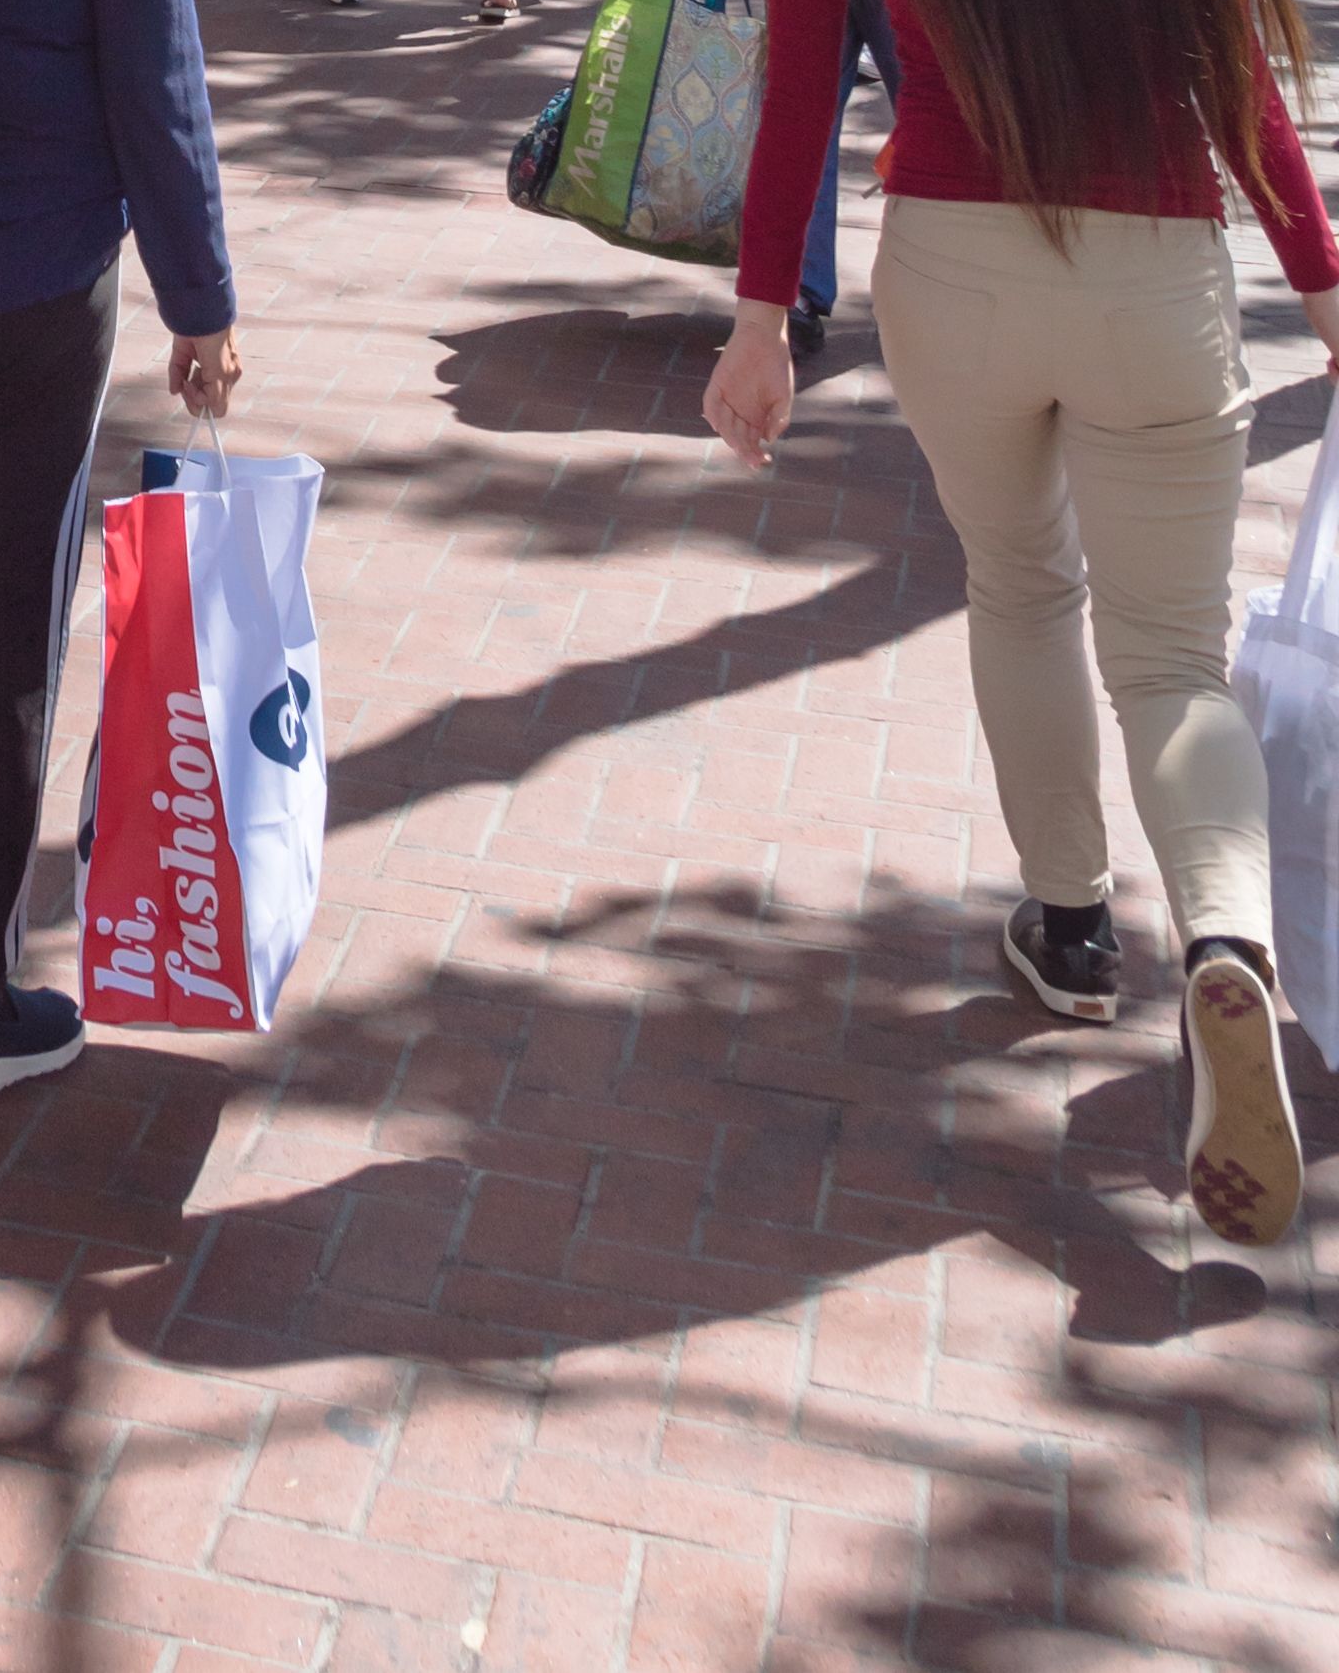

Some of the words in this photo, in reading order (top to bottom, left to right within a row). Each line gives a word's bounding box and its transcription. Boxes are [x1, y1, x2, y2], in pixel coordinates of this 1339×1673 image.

[568, 15, 631, 198] Marshalls
[152, 687, 245, 1022] fashion
[93, 896, 160, 1000] hi,
